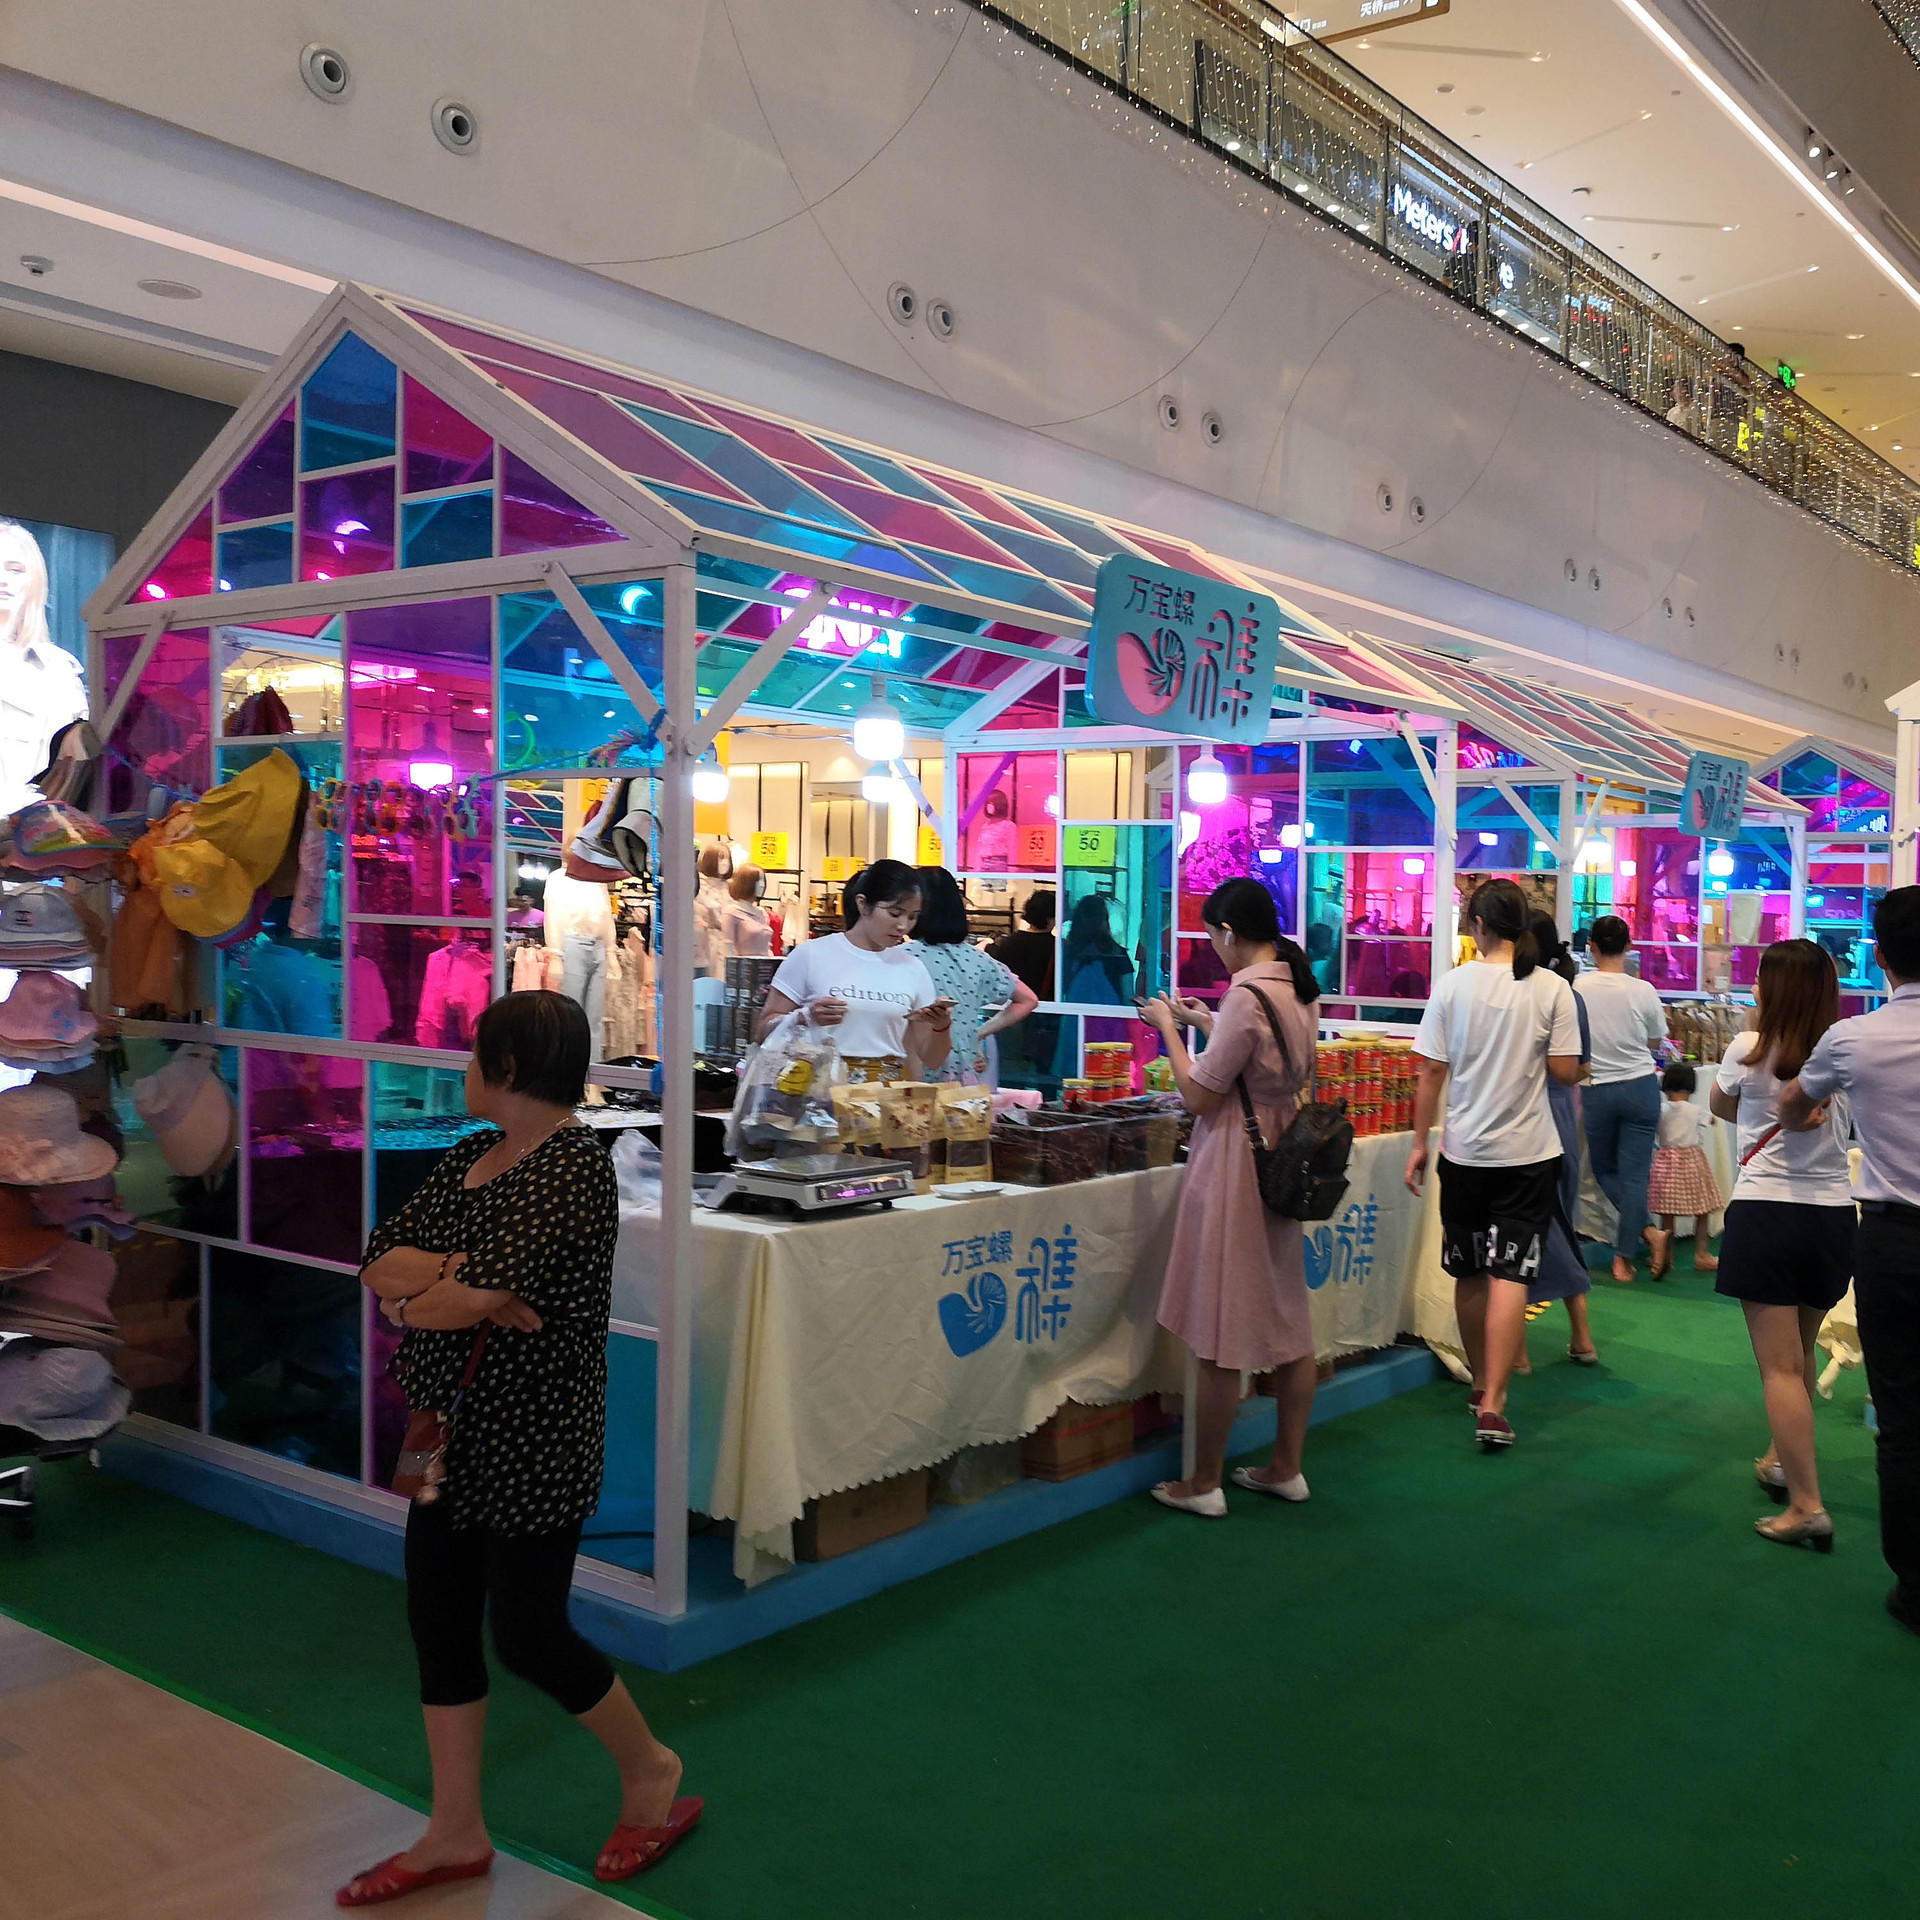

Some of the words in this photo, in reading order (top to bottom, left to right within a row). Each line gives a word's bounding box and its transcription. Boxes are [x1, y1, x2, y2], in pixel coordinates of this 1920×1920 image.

[1124, 574, 1195, 625] 万宝螺
[1078, 837, 1100, 851] 50
[941, 1230, 1014, 1277] 万宝螺
